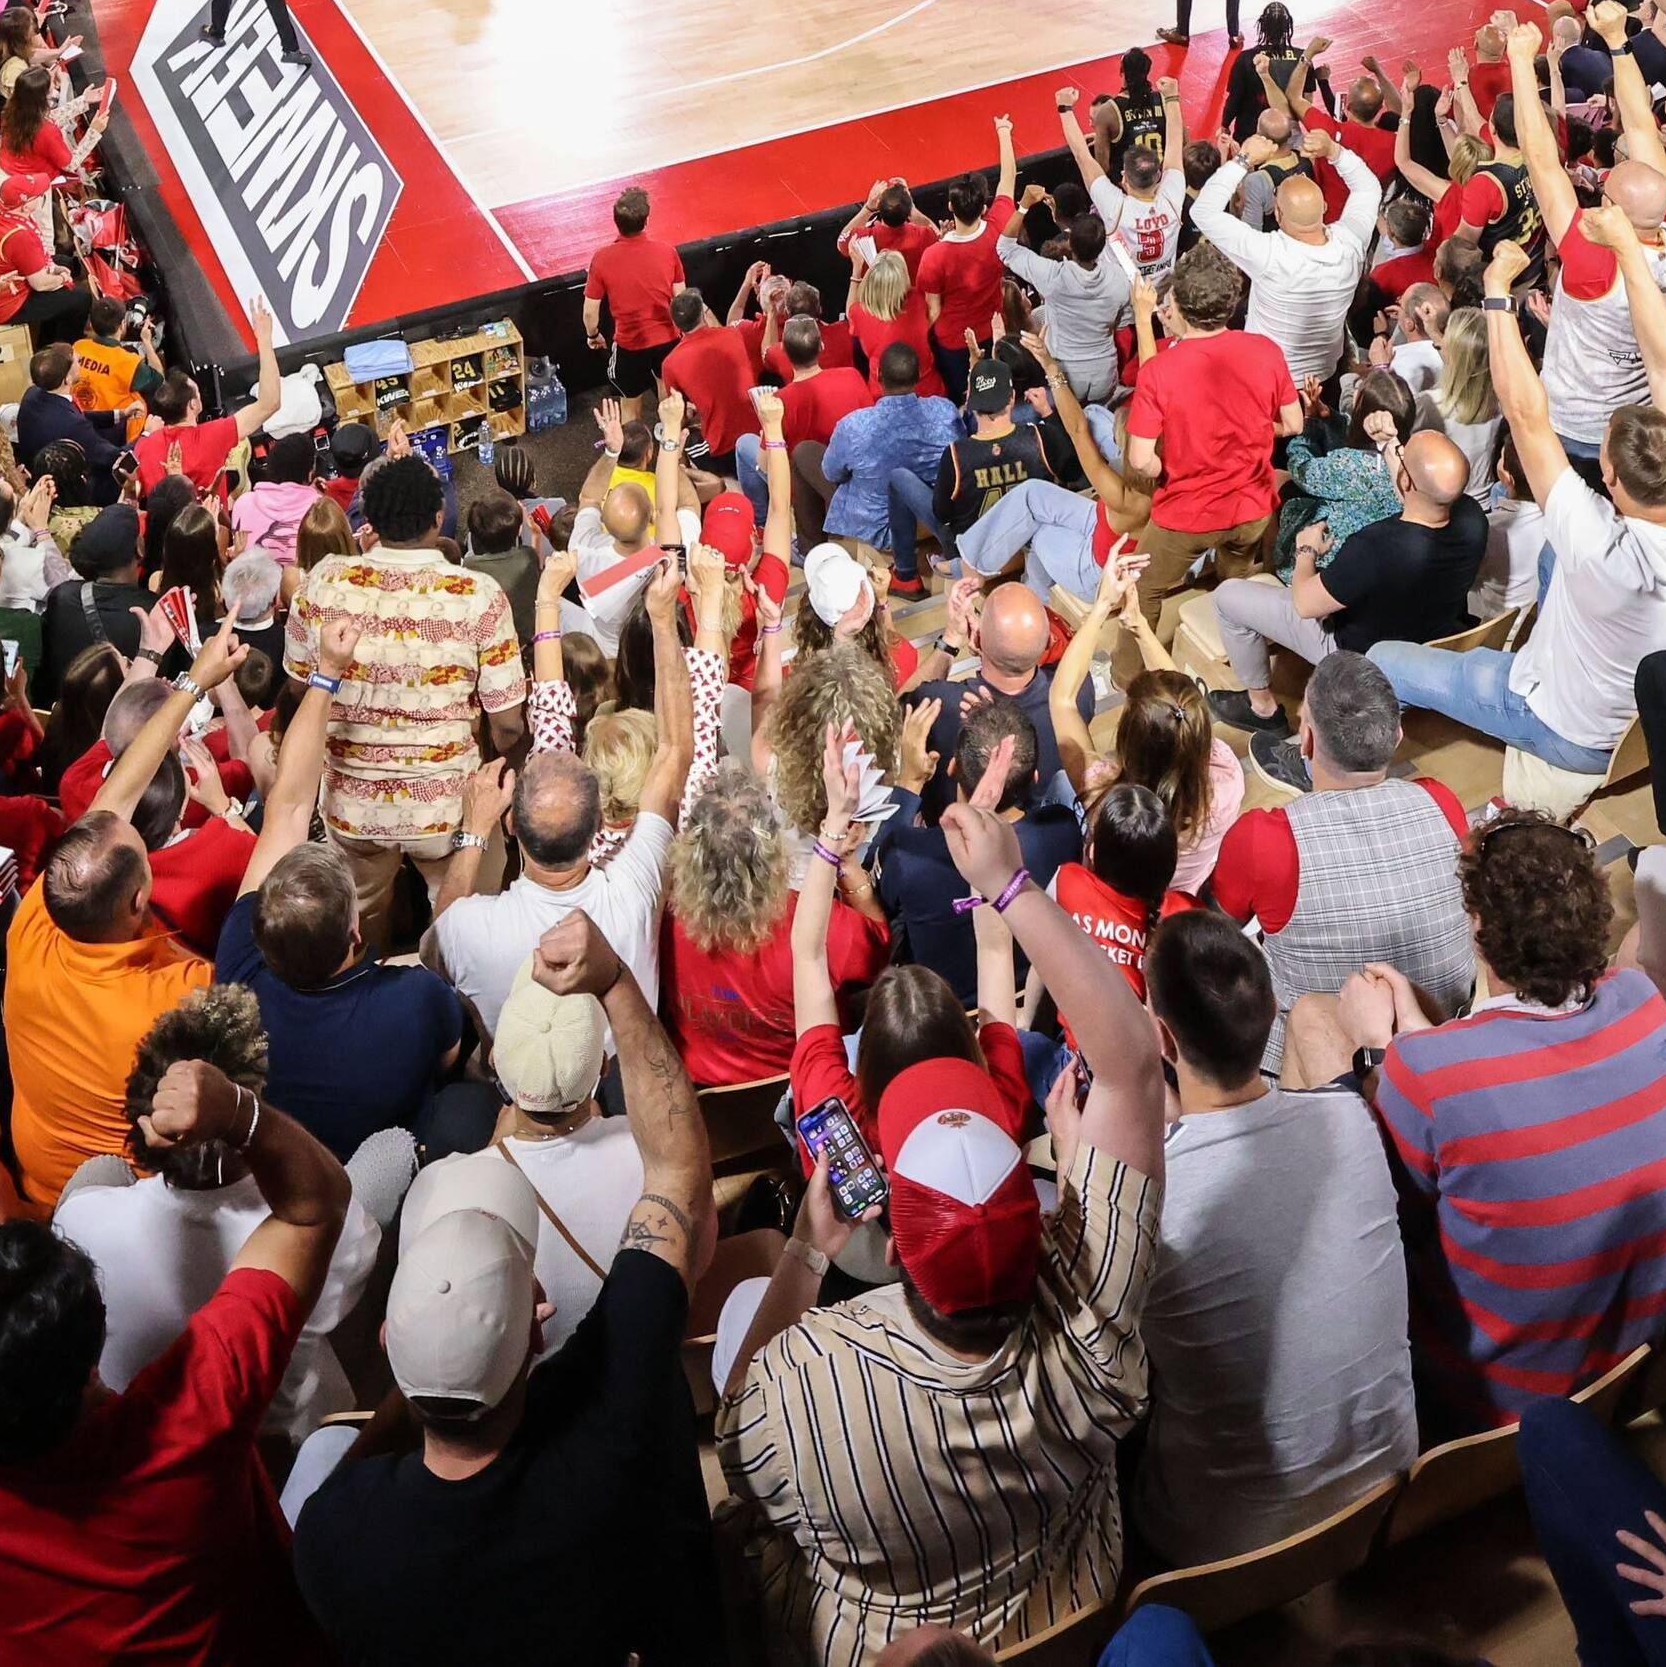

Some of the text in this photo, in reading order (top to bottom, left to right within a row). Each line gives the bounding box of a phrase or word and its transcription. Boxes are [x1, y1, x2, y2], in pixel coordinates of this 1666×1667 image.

[1137, 231, 1165, 264] 3
[452, 361, 476, 380] 24
[974, 461, 1027, 488] HALL
